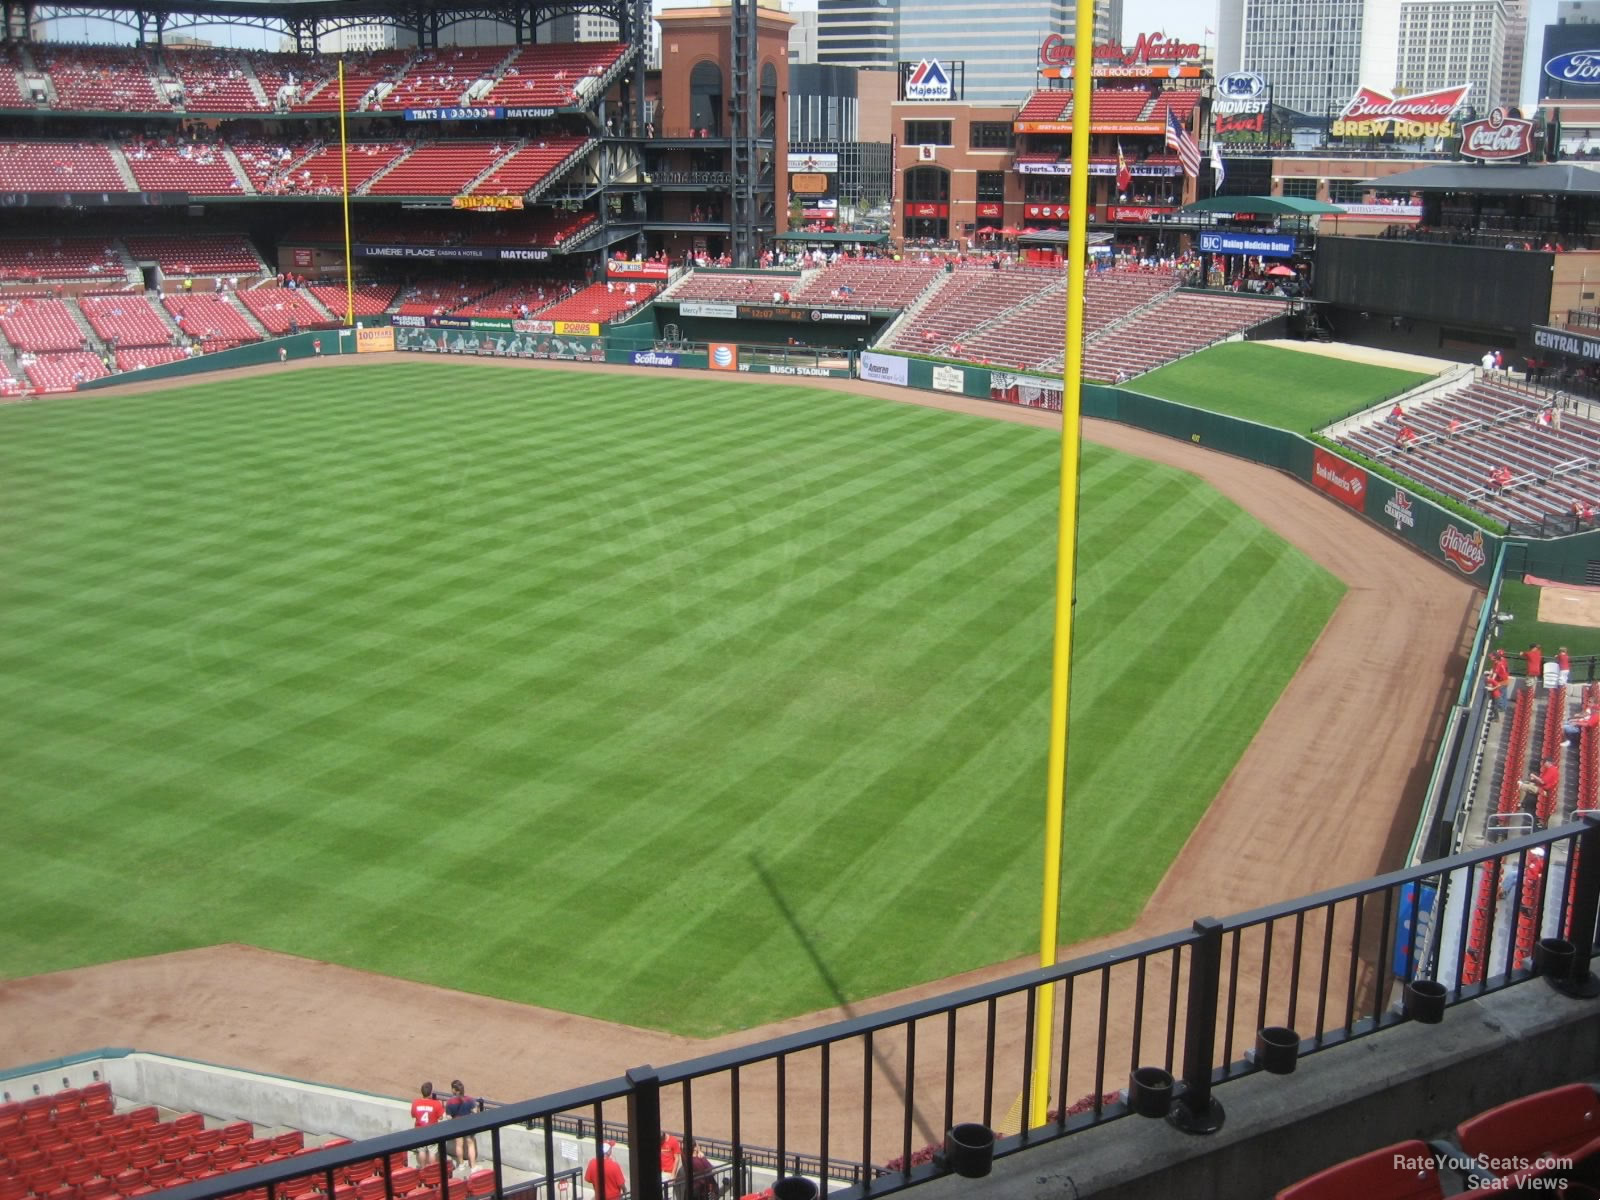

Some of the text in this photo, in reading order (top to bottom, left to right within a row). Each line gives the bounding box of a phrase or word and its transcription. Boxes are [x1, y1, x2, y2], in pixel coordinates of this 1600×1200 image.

[1041, 33, 1124, 65] Carals
[1108, 68, 1153, 77] ROOFTOP
[909, 85, 948, 97] Majestic
[1227, 77, 1254, 94] FOX
[1210, 100, 1269, 114] MIDWEST
[412, 109, 438, 119] THAT'S
[441, 109, 447, 119] A
[507, 108, 555, 119] MATCHUP
[1332, 120, 1389, 136] BREW
[1203, 237, 1219, 250] BJC
[405, 249, 436, 257] PLACE
[500, 250, 548, 259] MATCHUP
[563, 323, 590, 331] DOBBS
[1535, 330, 1580, 355] CENTRAL
[634, 352, 673, 365] Scottrade
[769, 365, 830, 377] BUSCH STADIUM
[420, 1112, 429, 1123] 4
